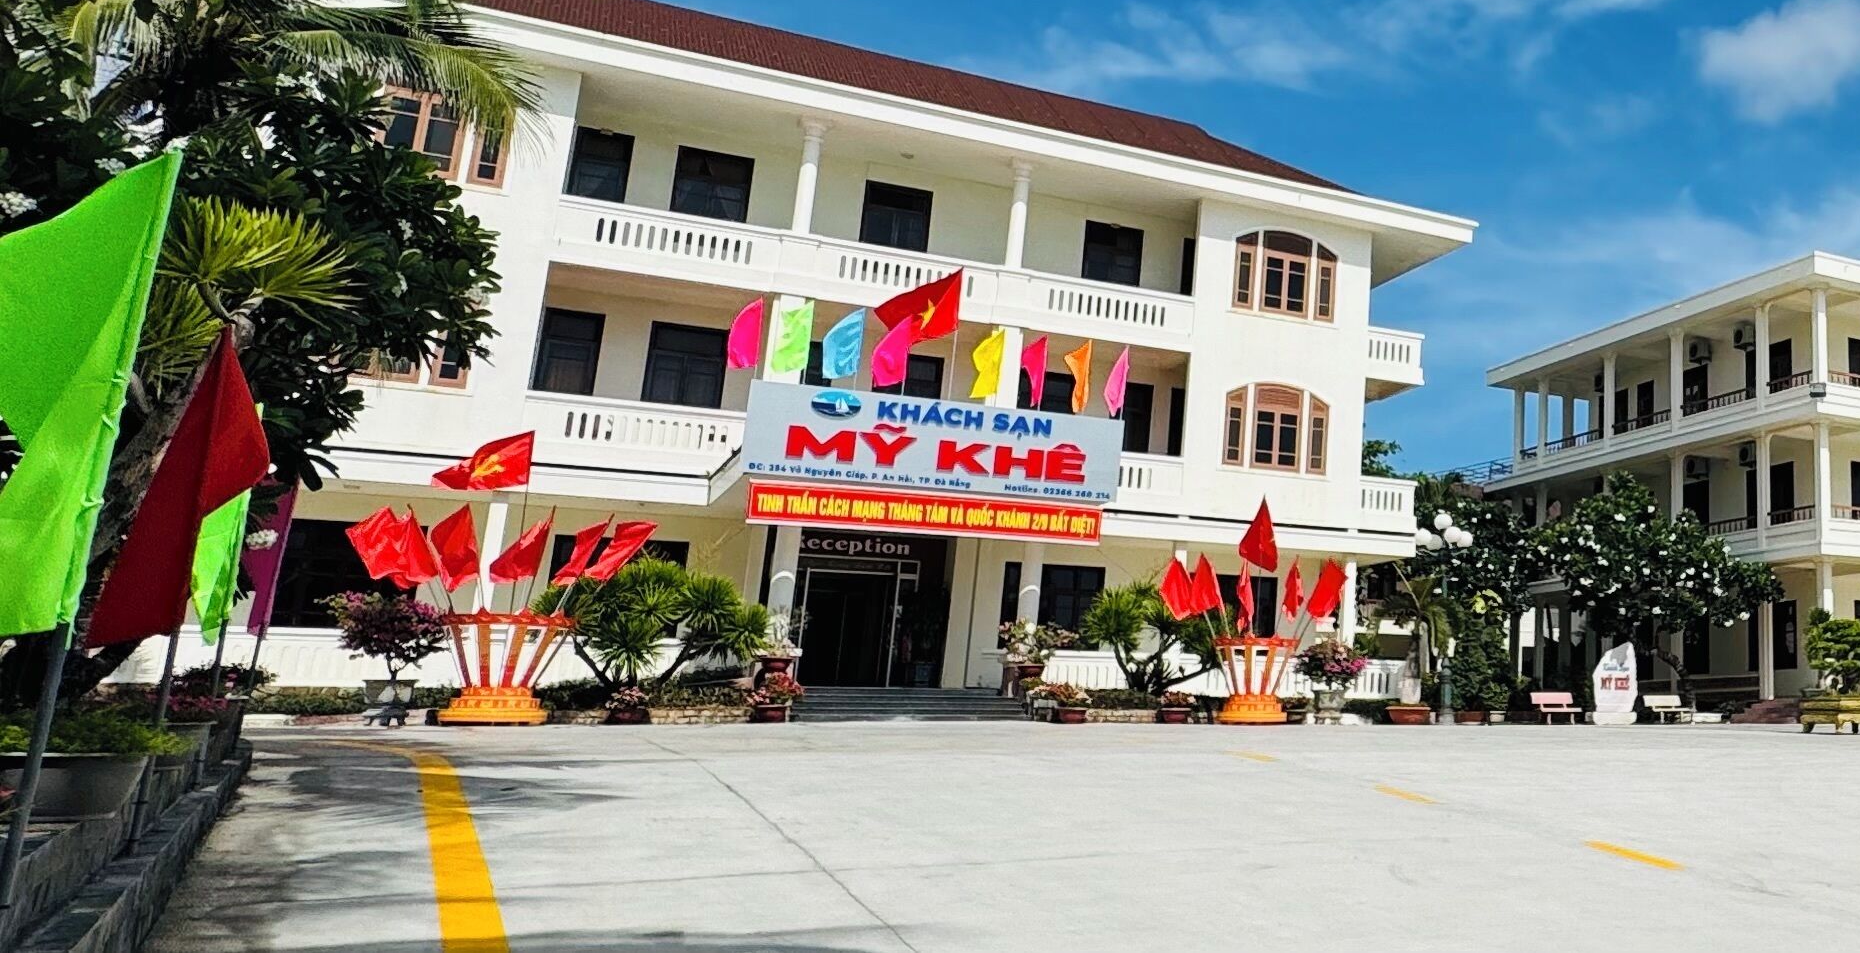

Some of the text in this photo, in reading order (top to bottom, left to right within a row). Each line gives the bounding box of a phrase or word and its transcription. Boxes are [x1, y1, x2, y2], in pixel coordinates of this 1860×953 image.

[877, 401, 1053, 440] KHÁCH SẠN
[785, 423, 1086, 485] MỸ KHÊ
[757, 493, 785, 513] TINH
[819, 494, 850, 517] CÁCH
[852, 499, 886, 523] MẠNG
[888, 499, 924, 522] THÁNG
[925, 502, 949, 524] TÁM
[950, 504, 964, 525] VÀ
[966, 502, 994, 527] QUỐC
[995, 508, 1031, 529] KHÁNH
[1031, 514, 1048, 531] 2/9
[1049, 509, 1071, 532] BẤT
